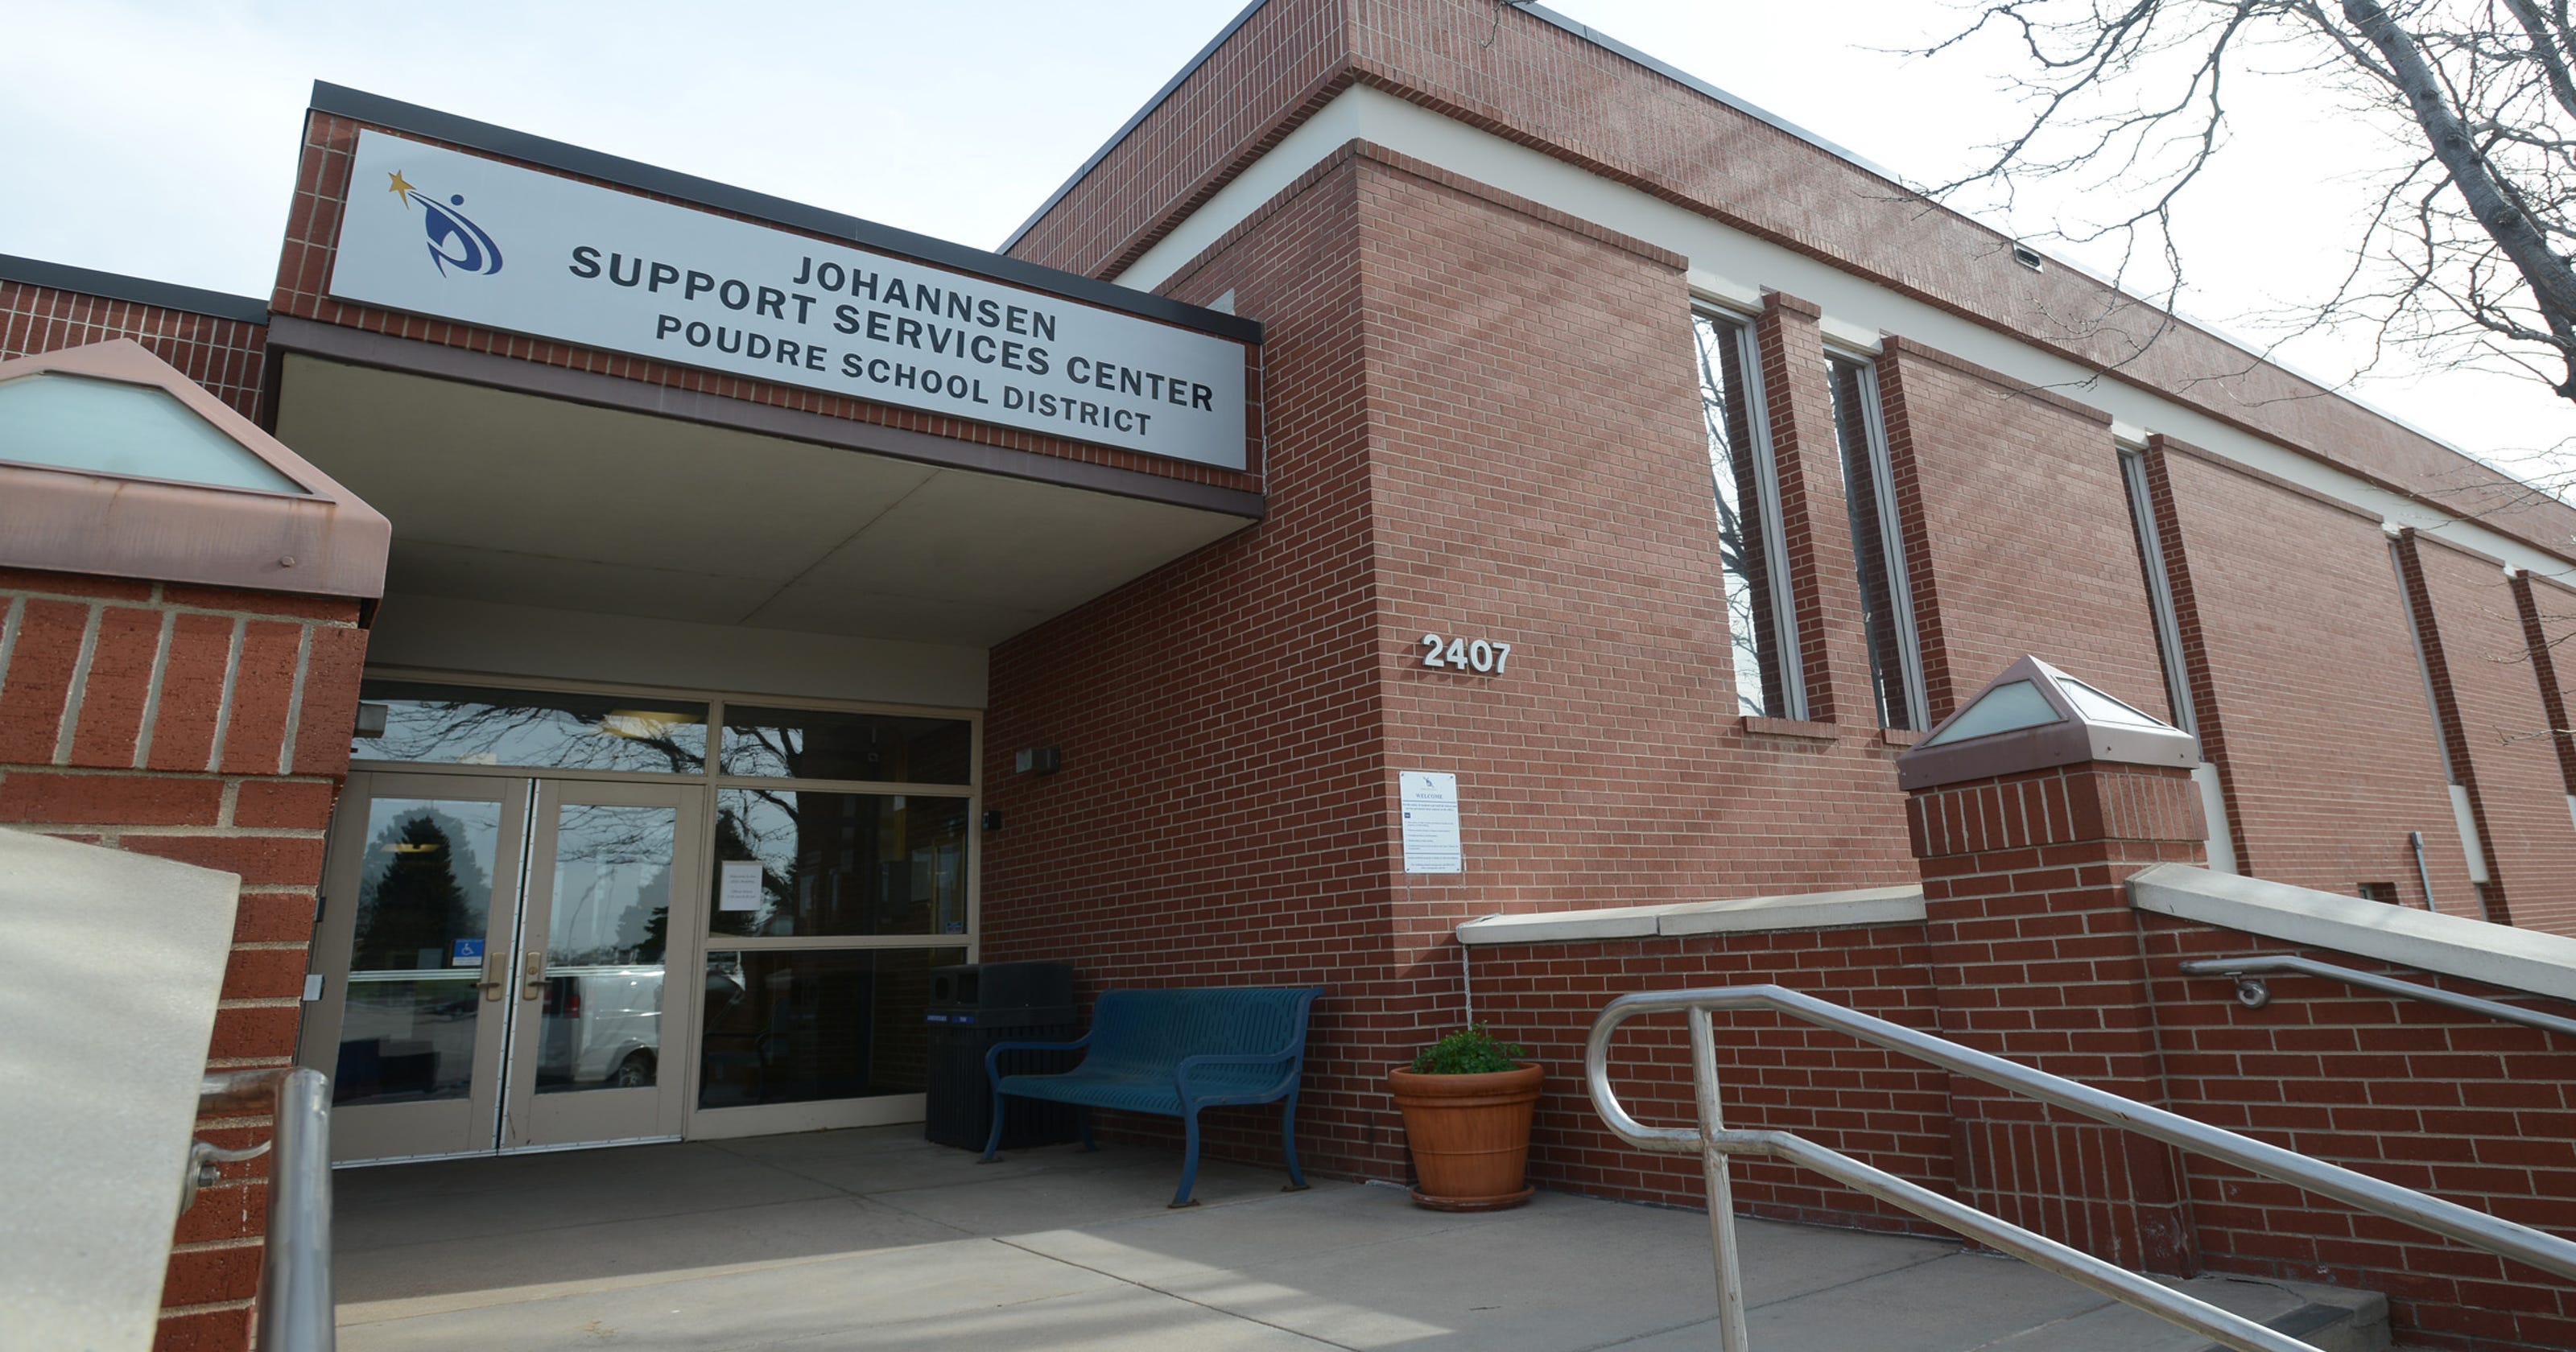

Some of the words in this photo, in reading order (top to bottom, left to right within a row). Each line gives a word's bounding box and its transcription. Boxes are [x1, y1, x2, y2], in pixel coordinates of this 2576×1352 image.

[568, 245, 818, 326] SUPPORT
[832, 303, 1051, 377] SERVICES
[1066, 355, 1214, 414] CENTER
[792, 255, 1057, 343] JOHANNSEN
[655, 313, 828, 373] POUDRE
[840, 352, 989, 406] SCHOOL
[1002, 385, 1152, 437] DISTRICT
[1422, 633, 1512, 674] 2407
